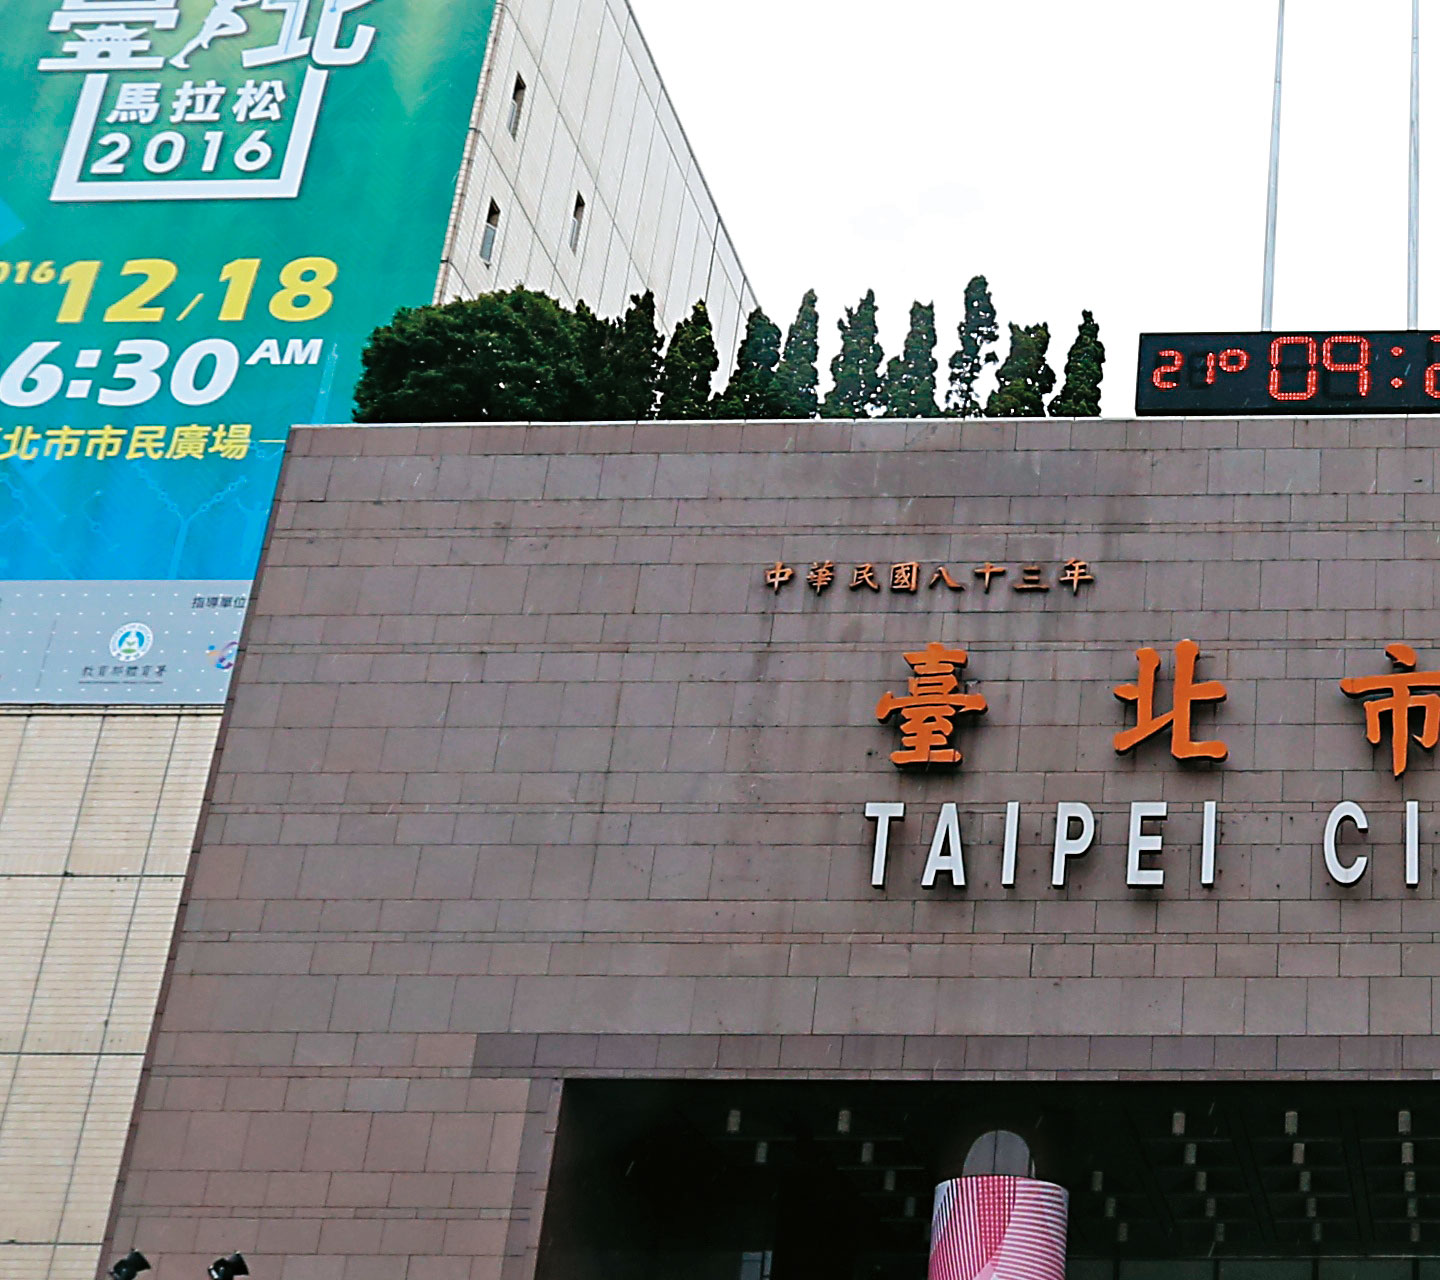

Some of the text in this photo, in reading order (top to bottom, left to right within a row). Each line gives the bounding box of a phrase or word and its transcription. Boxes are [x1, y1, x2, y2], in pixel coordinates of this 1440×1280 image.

[105, 81, 287, 125] 馬拉松
[89, 130, 275, 175] 2016
[54, 256, 338, 323] 12/18
[246, 339, 322, 366] AM
[764, 558, 1097, 596] 中華民國八十三年
[192, 596, 246, 609] 指導單位
[864, 800, 1217, 889] TAIPEI
